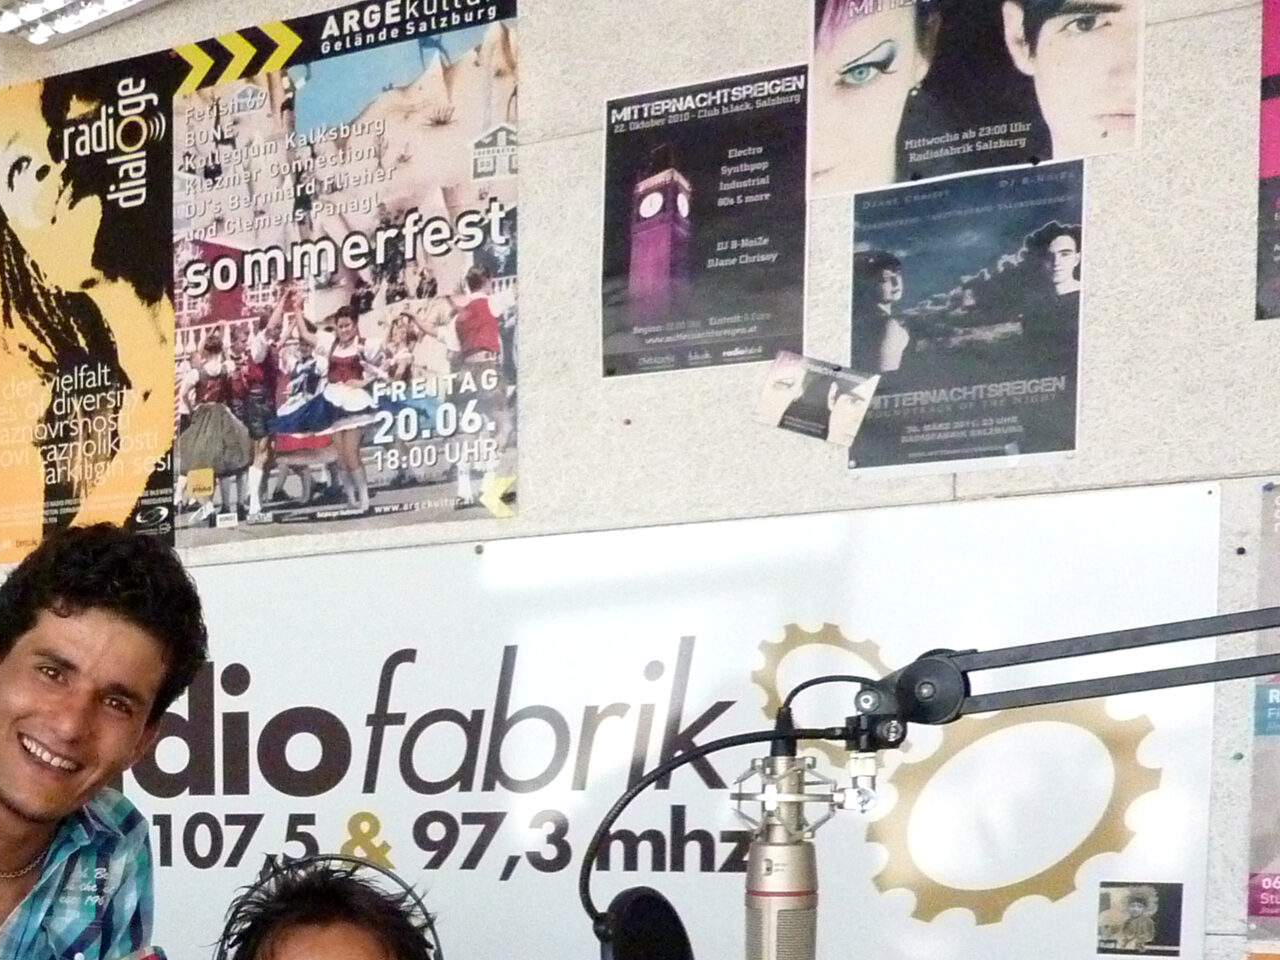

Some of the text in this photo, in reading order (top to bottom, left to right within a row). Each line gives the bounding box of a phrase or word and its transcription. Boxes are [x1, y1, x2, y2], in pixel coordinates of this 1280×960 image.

[321, 5, 497, 54] Gelände Salzburg
[184, 89, 268, 125] Fetish 69
[611, 74, 806, 124] MITTERNACHTSREIGEN
[755, 93, 802, 108] Salzburg
[184, 127, 238, 148] BONE
[184, 118, 387, 172] Kollegium Kalksburg
[728, 146, 763, 159] Electro
[904, 121, 1032, 150] Mittwochs ab 23:00 Uhr
[908, 136, 1027, 163] Radiofabrik Salzburg
[184, 143, 378, 196] Klezmer Connection
[719, 175, 770, 191] Industrial
[720, 161, 769, 175] Synthpop
[184, 165, 398, 220] DJ's Bernhard Flieher
[183, 192, 381, 244] und Clemens Panagl
[184, 197, 509, 297] sommerfest
[2, 376, 39, 401] der
[45, 362, 111, 393] vielfalt
[372, 368, 500, 404] FREITAG
[52, 382, 137, 421] diversity
[372, 398, 497, 445] 20.06.
[39, 431, 158, 464] raznolikosti
[372, 437, 500, 473] 18:00 UHR
[339, 811, 395, 870] &
[412, 810, 573, 881] 97,3
